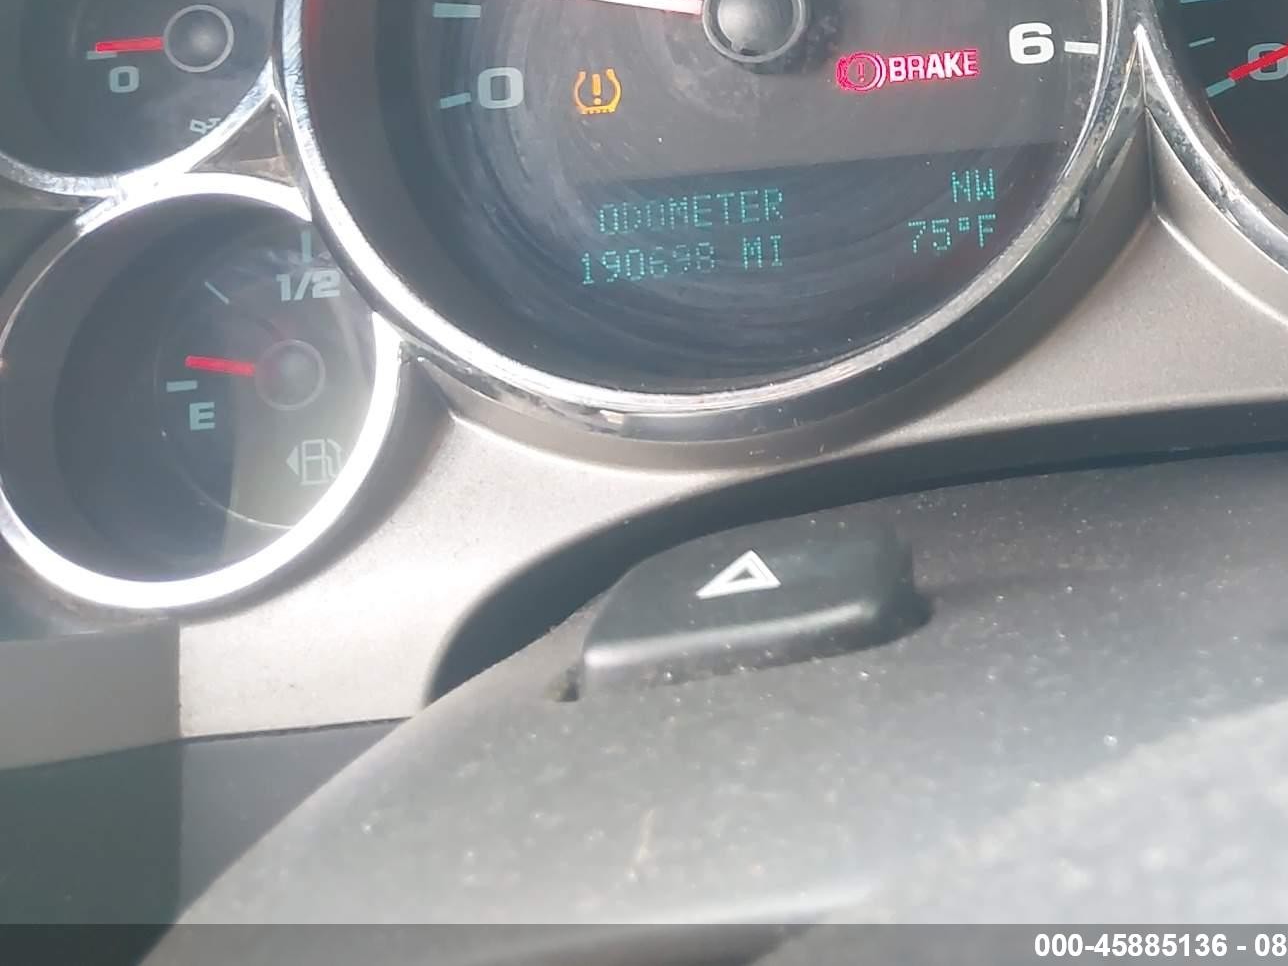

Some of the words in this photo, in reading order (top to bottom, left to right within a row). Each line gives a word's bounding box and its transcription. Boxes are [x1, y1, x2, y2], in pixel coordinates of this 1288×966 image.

[1008, 23, 1054, 64] 6
[109, 66, 140, 94] 0
[889, 49, 978, 82] BRAKE
[478, 67, 524, 109] 0
[951, 168, 996, 203] NW
[600, 188, 784, 235] ODOMETER
[743, 234, 784, 271] MI
[276, 268, 341, 302] 1/2
[189, 402, 216, 430] E
